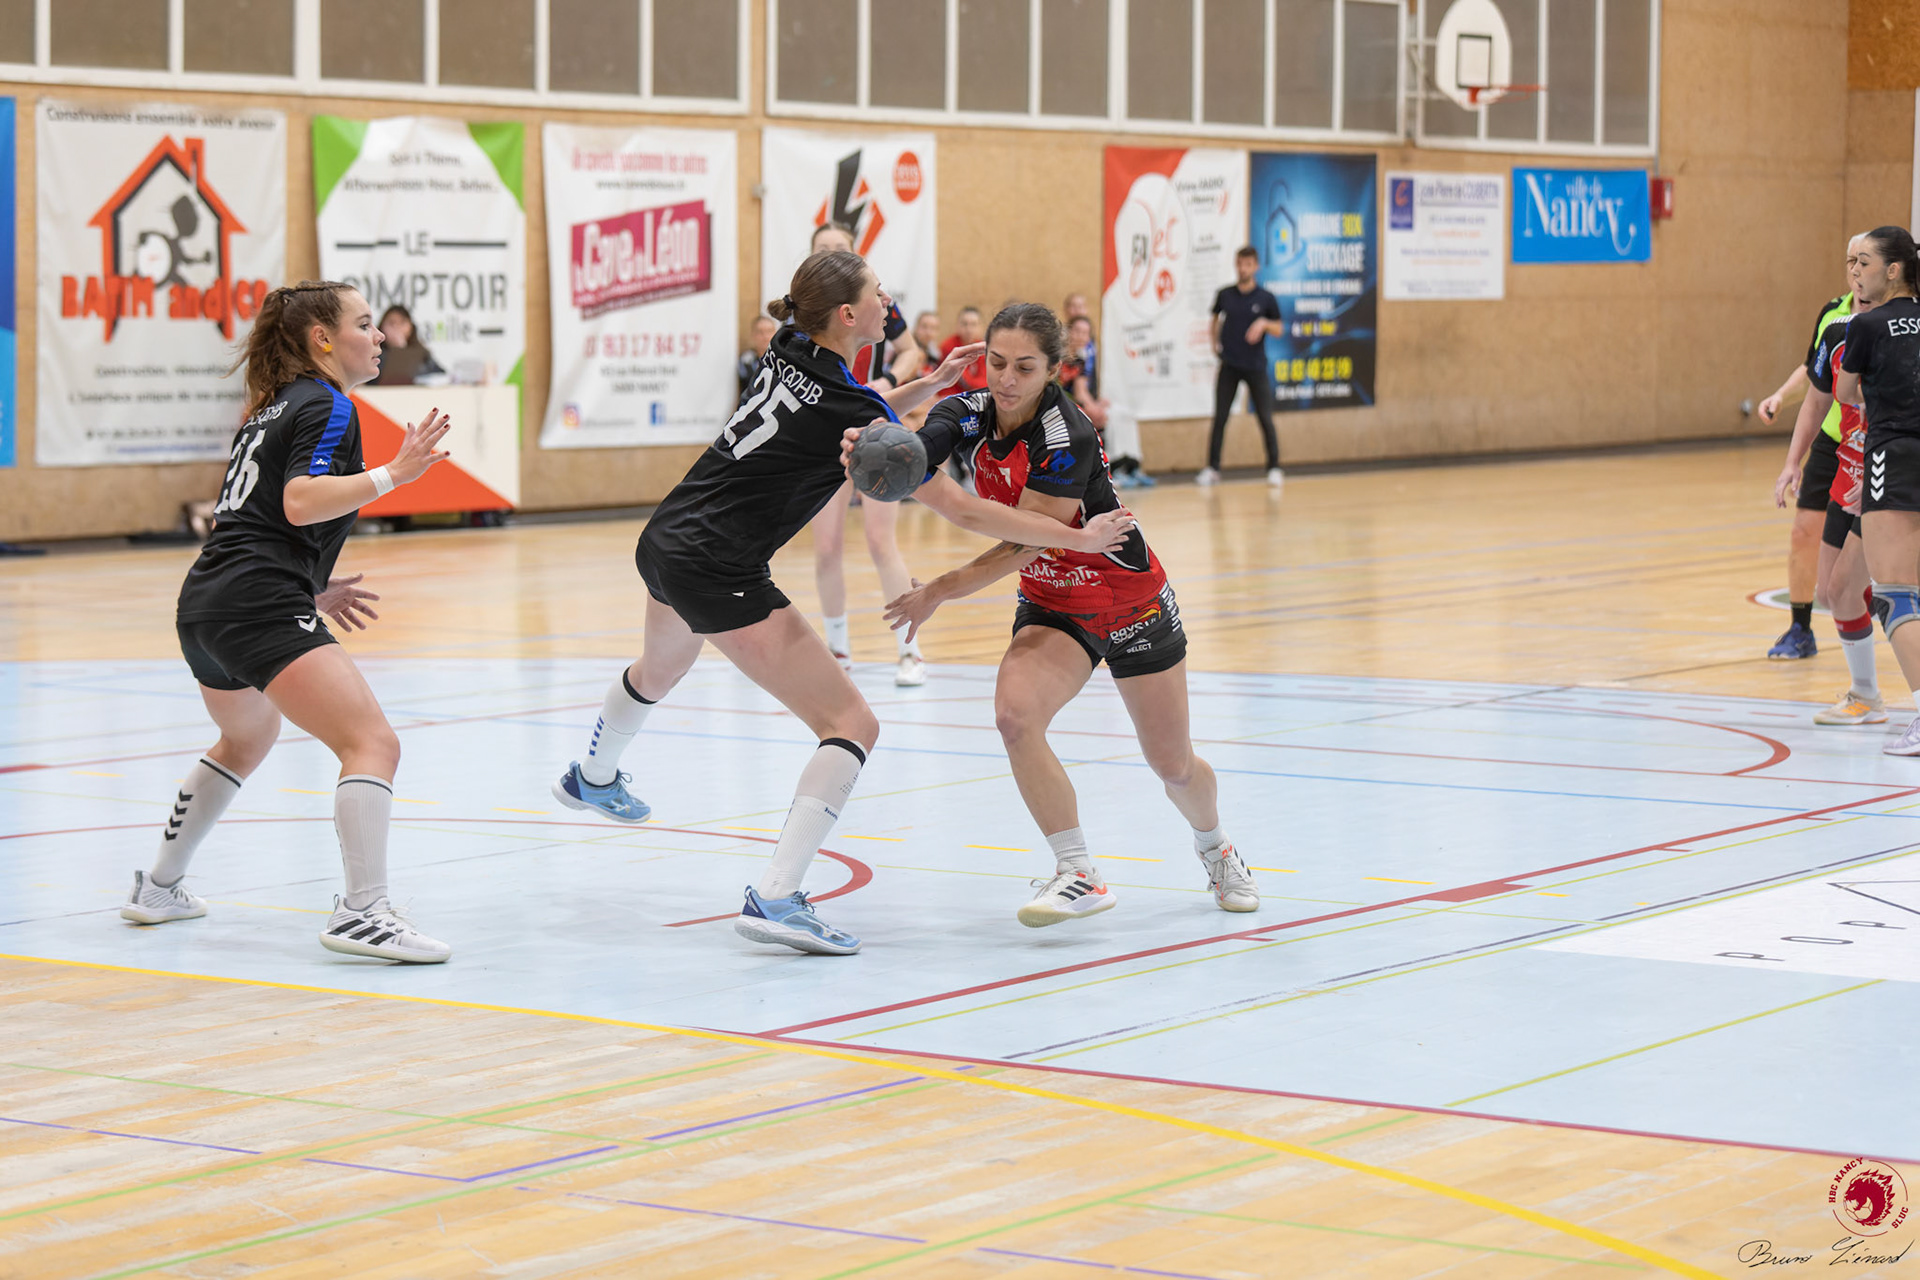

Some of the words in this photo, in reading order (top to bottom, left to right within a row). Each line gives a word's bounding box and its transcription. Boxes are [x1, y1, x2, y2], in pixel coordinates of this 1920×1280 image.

[1522, 173, 1637, 256] Nancy
[404, 230, 430, 255] LE
[643, 207, 700, 277] Léon
[1305, 242, 1366, 273] STOCKAGE
[169, 278, 230, 321] and
[341, 273, 509, 314] OMPTOIR
[723, 366, 803, 461] 25
